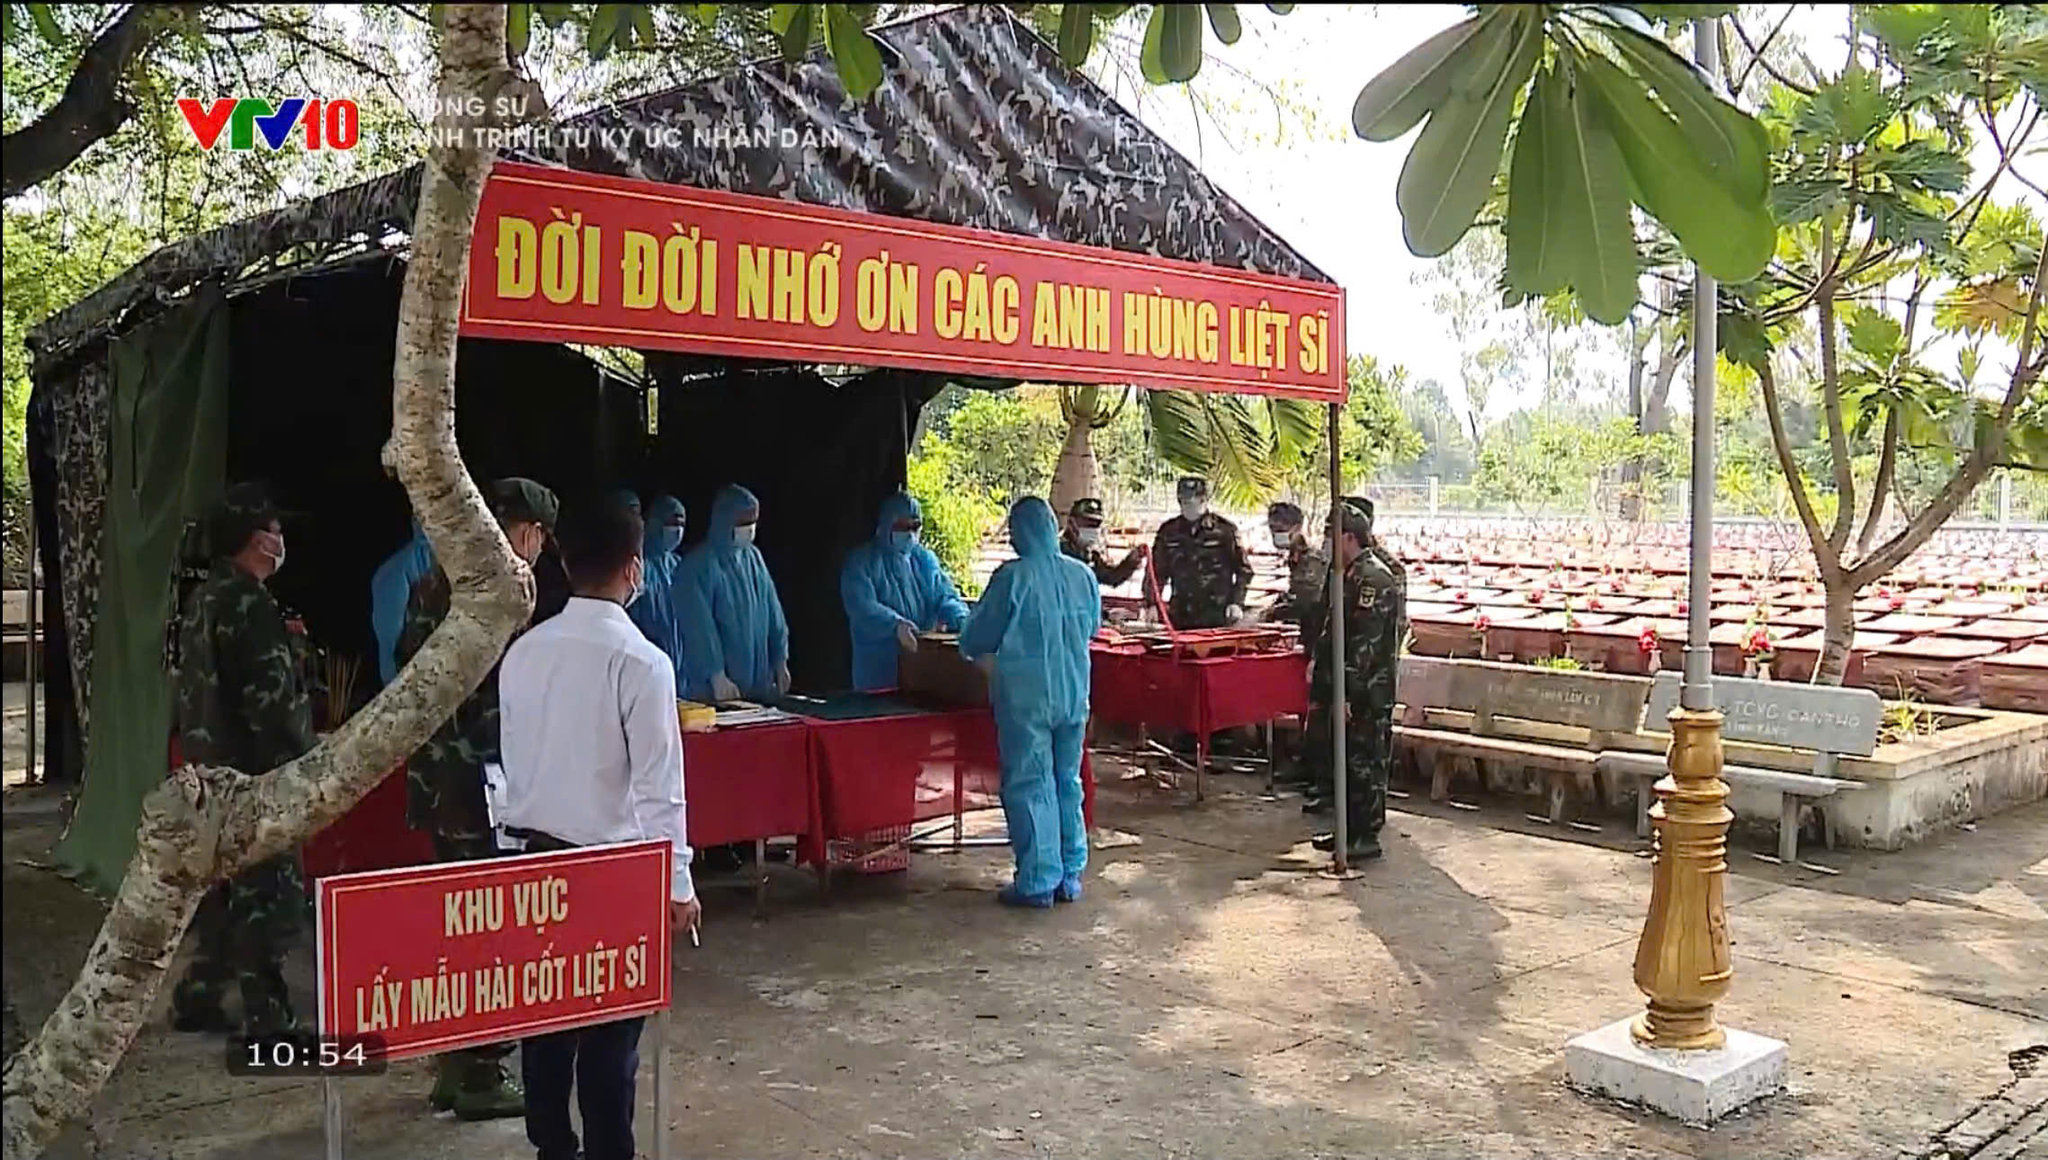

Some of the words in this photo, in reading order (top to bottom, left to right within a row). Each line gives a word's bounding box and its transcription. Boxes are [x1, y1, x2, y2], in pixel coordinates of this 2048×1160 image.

[495, 207, 601, 306] ĐỜI
[621, 222, 718, 317] ĐỜI
[736, 242, 842, 328] NHỚ
[856, 250, 919, 335] ƠN
[934, 263, 1020, 345] CÁC
[1031, 280, 1112, 354] ANH
[1123, 286, 1220, 364] HÙNG
[1229, 302, 1291, 378] LIỆT
[1300, 309, 1330, 375] SĨ
[444, 884, 505, 937] KHU
[513, 874, 569, 935] VỰC
[356, 965, 403, 1034] LẤY
[410, 956, 468, 1025] MẪU
[474, 956, 515, 1015] HÀI
[522, 941, 568, 1007] CỐT
[572, 940, 619, 1004] LIỆT
[624, 933, 649, 990] SĨ
